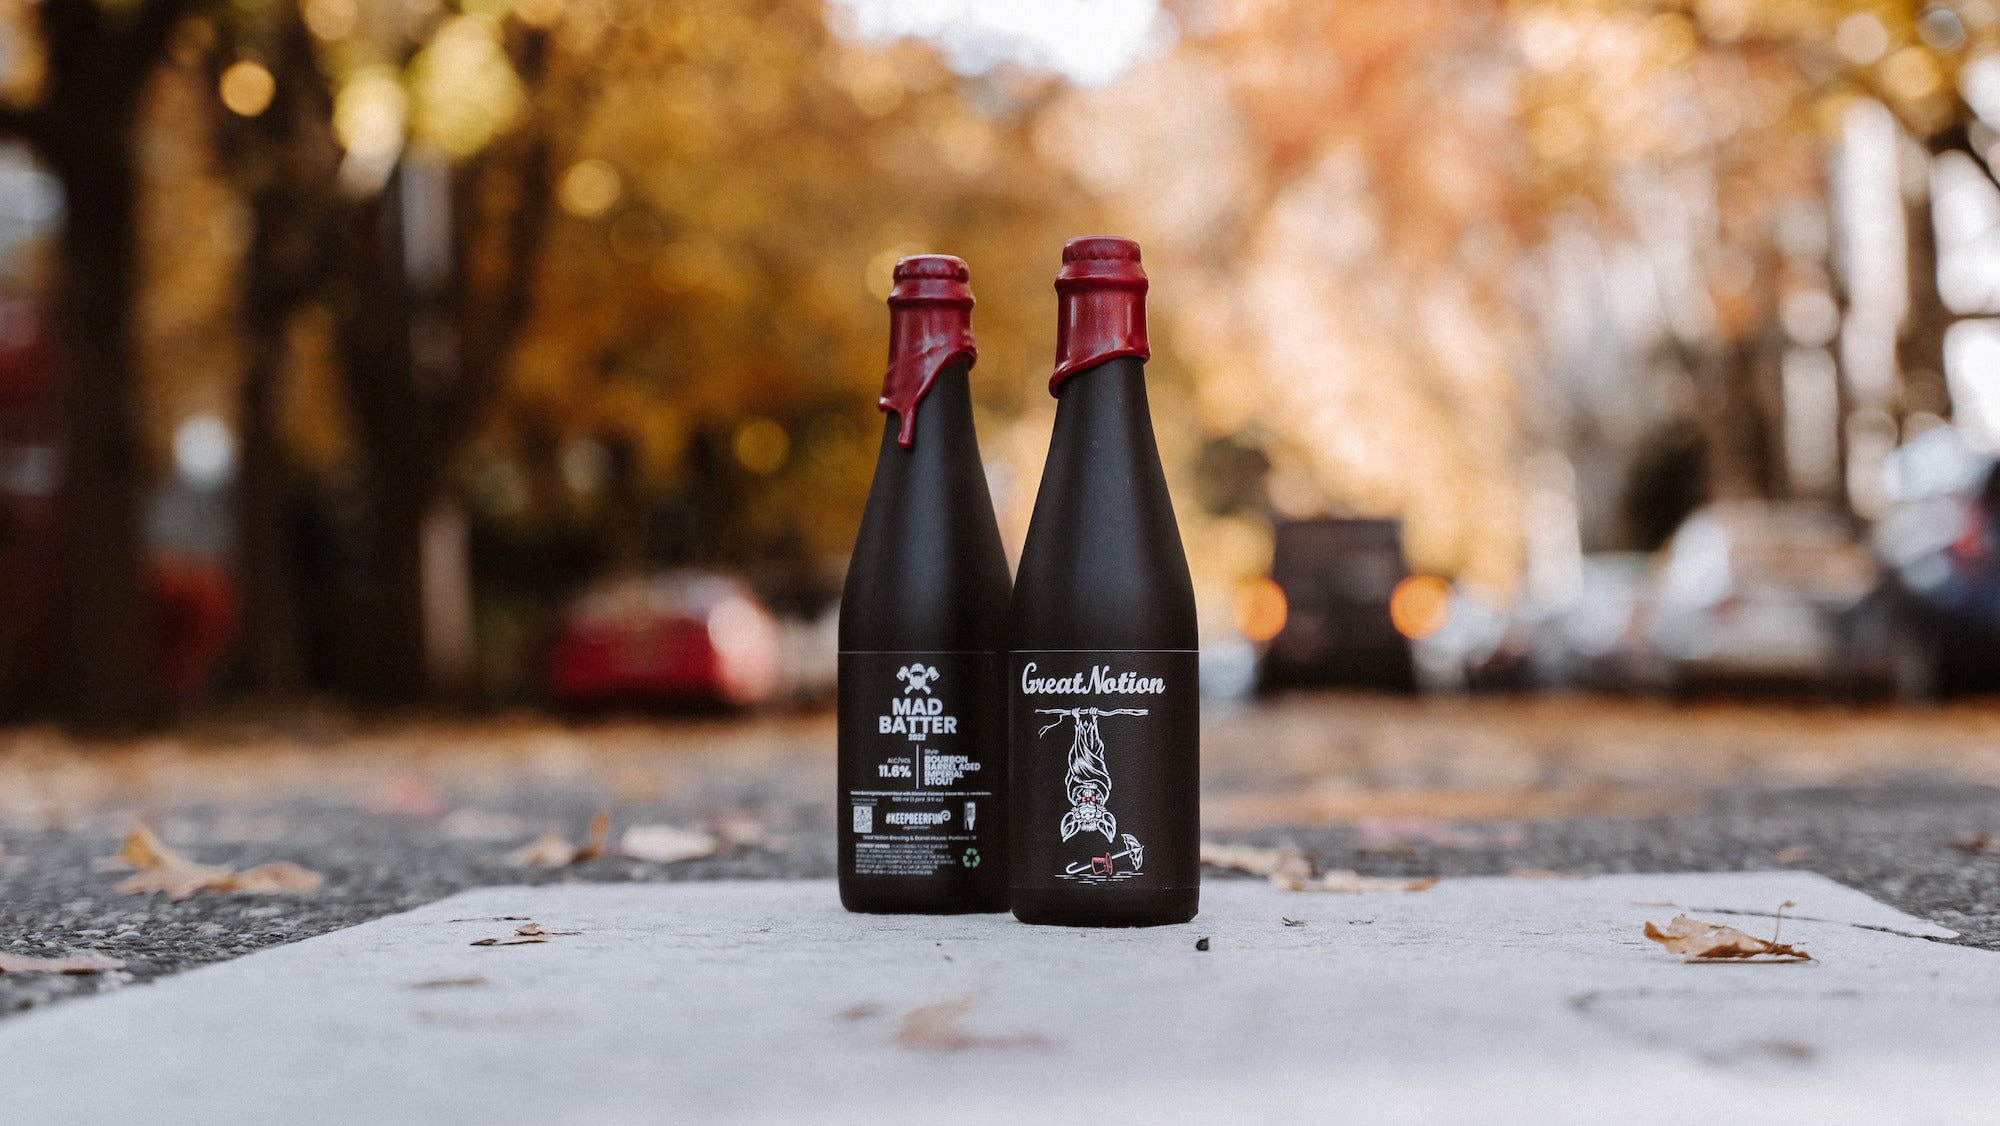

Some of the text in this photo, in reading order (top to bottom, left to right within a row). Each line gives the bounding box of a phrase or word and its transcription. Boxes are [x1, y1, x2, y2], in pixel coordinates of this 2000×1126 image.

[1021, 662, 1166, 695] Great Notion
[891, 697, 943, 716] MAD
[878, 715, 958, 734] BATTER
[908, 733, 926, 741] 2022
[924, 755, 968, 764] BOURBON
[878, 764, 912, 778] 11.6%
[924, 762, 981, 771] BARREL AGED
[924, 770, 964, 778] IMPERIAL
[924, 777, 954, 786] STOUT
[885, 812, 943, 825] #KEEPBEERFUN
